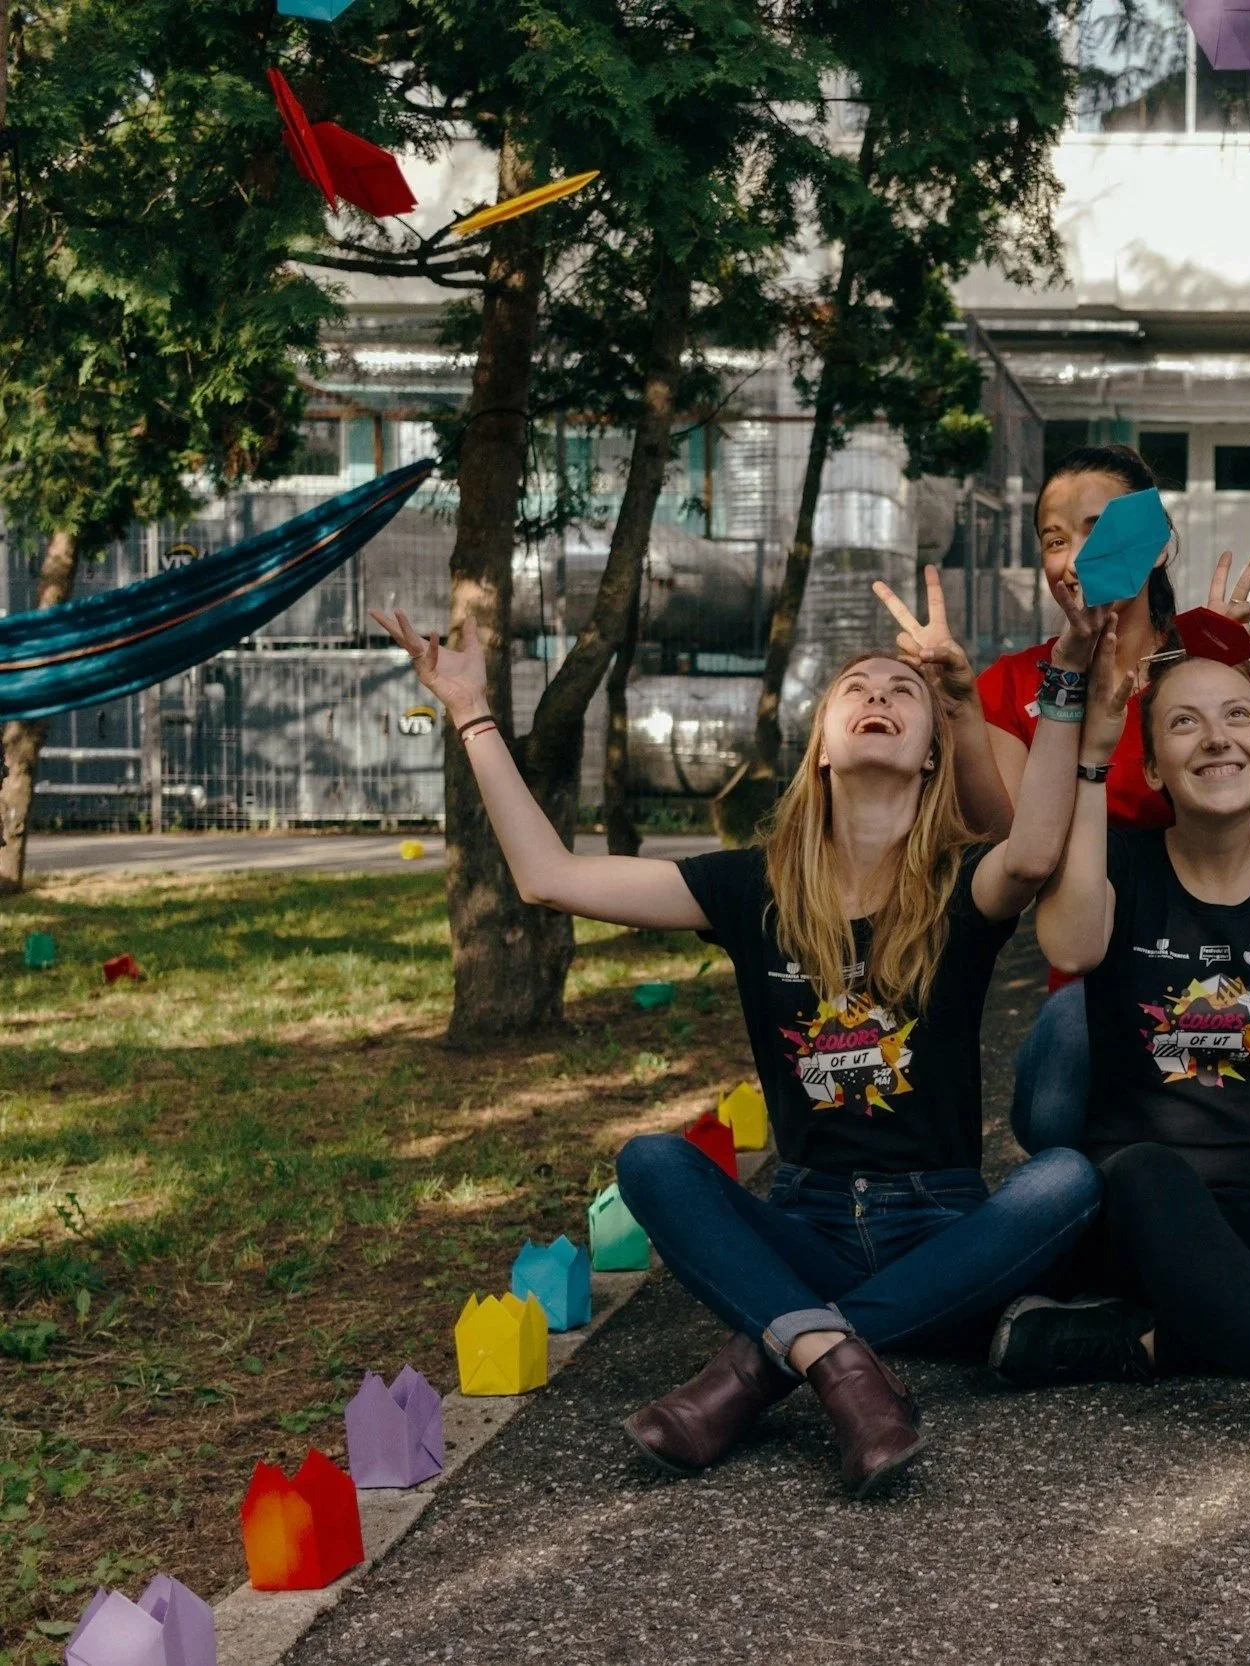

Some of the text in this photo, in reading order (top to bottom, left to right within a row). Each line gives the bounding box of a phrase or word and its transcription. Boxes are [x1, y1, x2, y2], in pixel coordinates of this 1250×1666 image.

[400, 716, 432, 734] VTS
[1179, 1012, 1246, 1030] COLORS
[815, 1028, 879, 1050] COLORS
[1190, 1035, 1232, 1047] OF UT
[830, 1051, 870, 1067] OF UT
